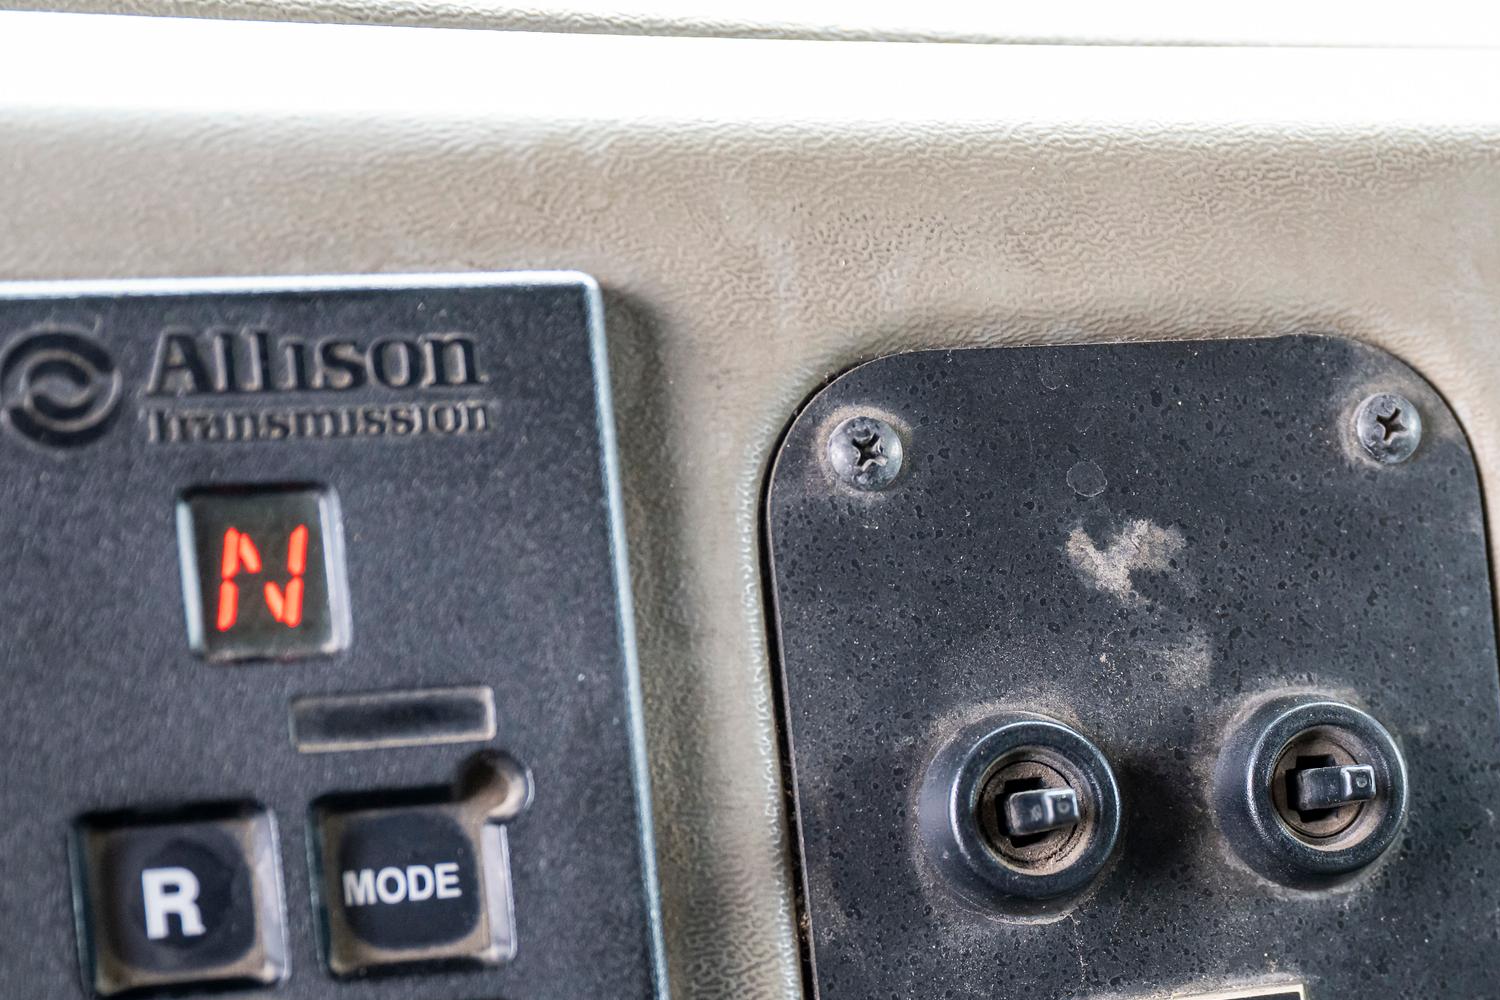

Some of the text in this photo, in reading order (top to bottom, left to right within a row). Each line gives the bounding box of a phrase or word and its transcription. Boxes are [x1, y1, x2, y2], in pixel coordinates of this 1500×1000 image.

[145, 325, 490, 395] Allison
[138, 401, 497, 443] Transmission
[216, 524, 309, 632] N
[141, 866, 206, 940] R
[342, 862, 462, 906] MODE
